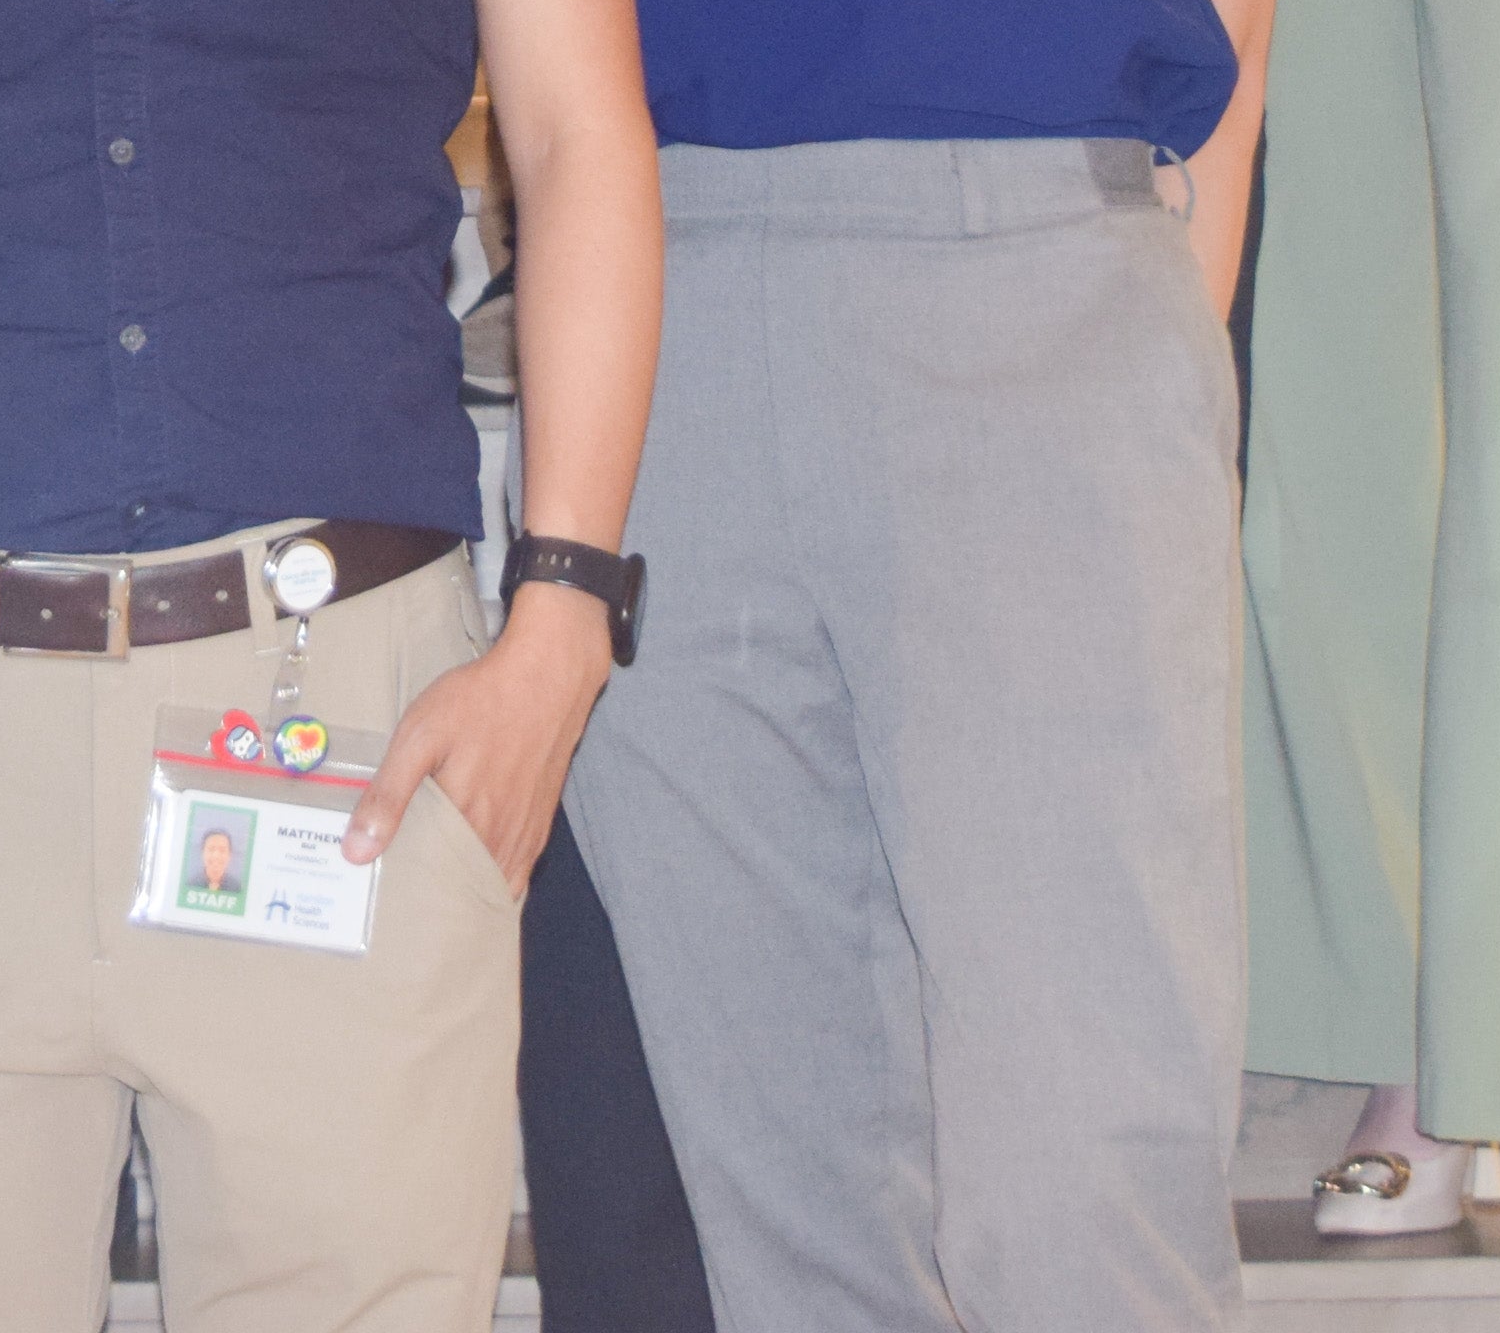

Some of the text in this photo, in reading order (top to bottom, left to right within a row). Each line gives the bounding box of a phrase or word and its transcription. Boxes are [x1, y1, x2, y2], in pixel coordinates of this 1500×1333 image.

[283, 746, 323, 766] KIND
[277, 825, 343, 845] MATTHEW
[186, 890, 238, 909] STAFF
